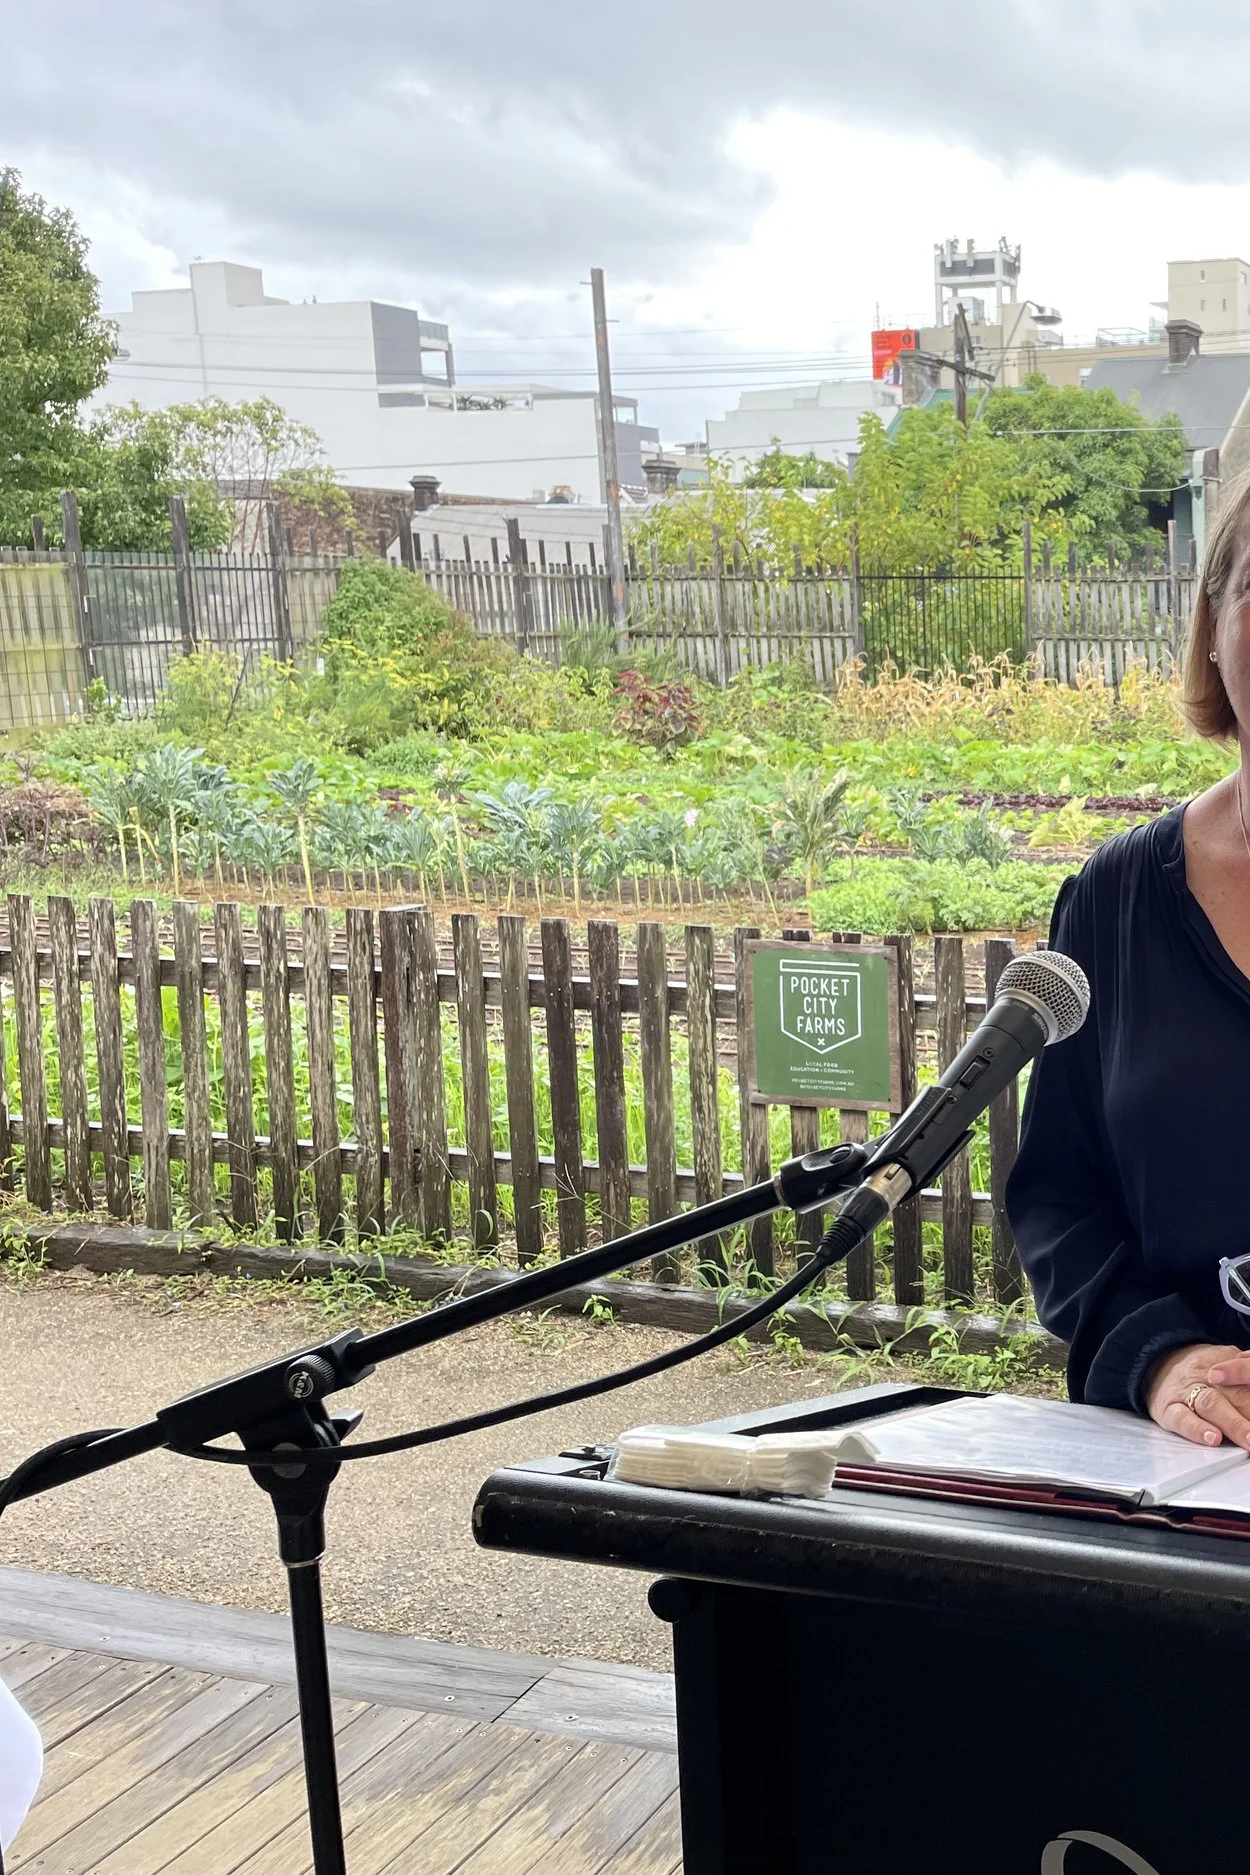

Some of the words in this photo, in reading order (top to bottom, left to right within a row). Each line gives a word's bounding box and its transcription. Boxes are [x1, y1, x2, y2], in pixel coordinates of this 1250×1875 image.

[791, 976, 850, 996] POCKET
[804, 997, 837, 1015] CITY
[797, 1016, 845, 1035] FARMS
